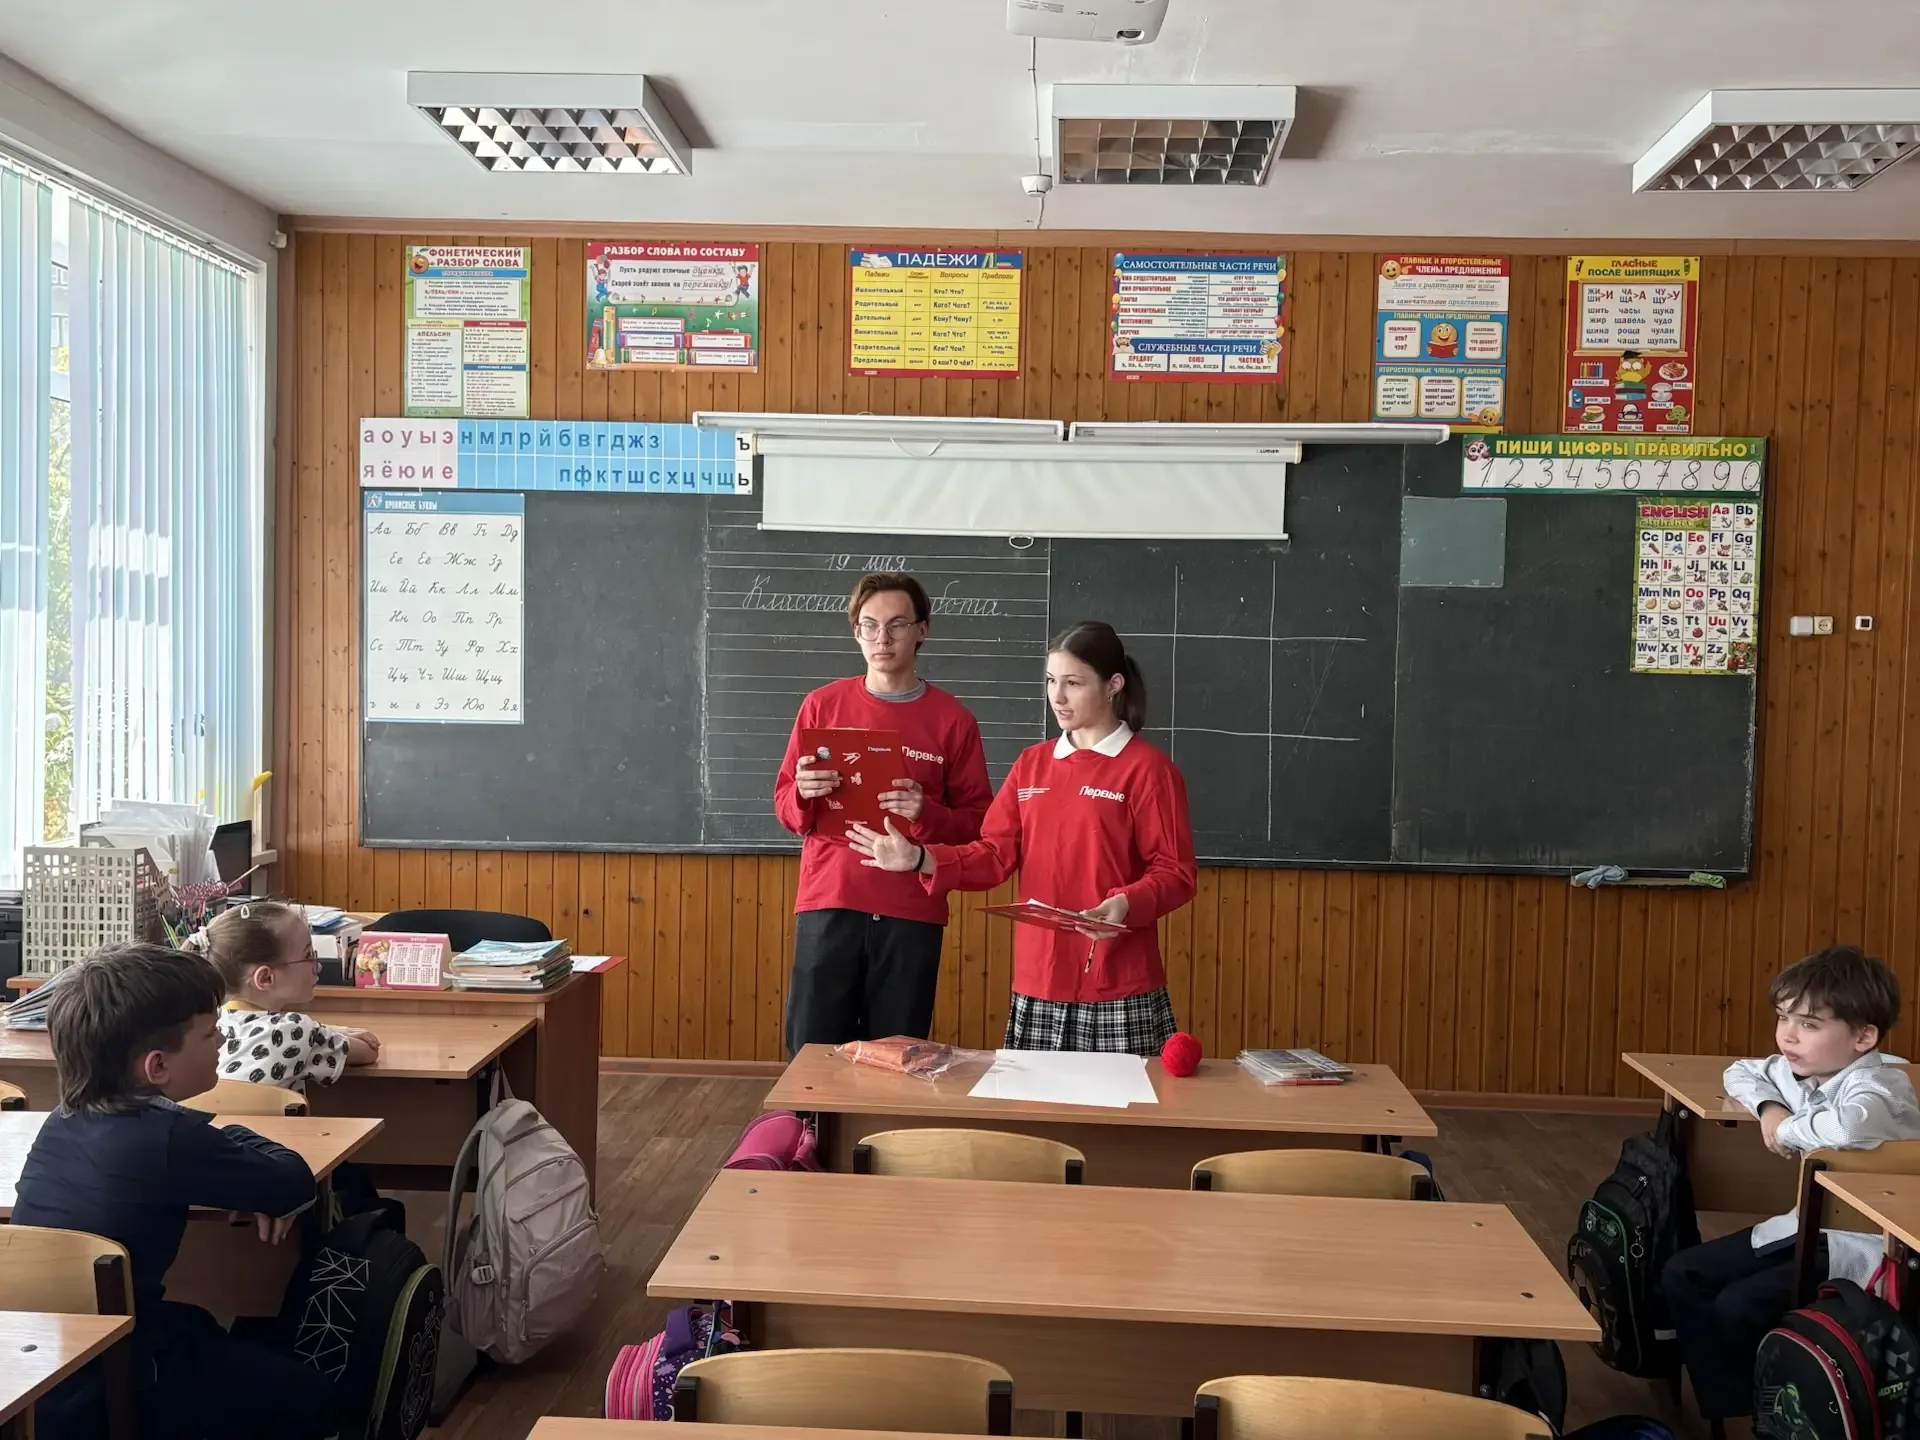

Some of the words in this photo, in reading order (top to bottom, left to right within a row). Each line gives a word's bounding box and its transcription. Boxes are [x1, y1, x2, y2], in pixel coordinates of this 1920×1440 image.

[429, 248, 521, 257] ФОНЕТИЧЕСКИЙ
[604, 247, 644, 255] РАЗБОР
[647, 247, 681, 256] СЛОВА
[684, 247, 697, 256] ПО
[700, 248, 745, 256] СОСТАВУ
[483, 259, 519, 267] СЛОВА
[897, 253, 977, 266] ПАДЕЖИ
[1441, 258, 1501, 266] ВТОРОСТЕПЕННЫЕ
[1611, 260, 1658, 268] ГЛАСНЫЕ
[619, 266, 636, 274] Пусть
[1123, 261, 1218, 270] САМОСТОЯТЕЛЬНЫЕ
[1219, 261, 1251, 270] ЧАСТИ
[1253, 262, 1276, 271] РЕЧИ
[1445, 266, 1501, 275] ПРЕДЛОЖЕНИЯ
[1588, 268, 1621, 276] ПОСЛЕ
[1624, 268, 1680, 277] ШИПЯЩИХ
[611, 279, 631, 287] Скорей
[1654, 317, 1673, 325] чудо
[1138, 344, 1196, 352] СЛУЖЕБНЫЕ
[1199, 344, 1231, 353] ЧАСТИ
[1234, 344, 1256, 353] РЕЧИ
[1496, 440, 1552, 454] ПИШИ
[1559, 441, 1628, 456] ЦИФРЫ
[1634, 442, 1748, 457] ПРАВИЛЬНО
[1641, 505, 1709, 518] ENGLISH
[1712, 505, 1730, 515] Aa
[1736, 505, 1753, 515] Bb
[1642, 532, 1658, 542] Cc
[1664, 532, 1682, 542] Dd
[1688, 532, 1704, 542] Ee
[1711, 532, 1724, 542] Ff
[1735, 533, 1753, 545] Gg
[825, 553, 850, 571] 19
[1640, 559, 1658, 569] Hh
[1663, 559, 1672, 569] Ii
[1687, 560, 1699, 572] Jj
[1710, 560, 1727, 570] Kk
[1734, 561, 1745, 571] Ll
[742, 575, 849, 612] Классна
[1639, 587, 1660, 597] Mm
[1662, 587, 1680, 597] Nn
[1686, 588, 1704, 598] Oo
[1709, 588, 1726, 601] Pp
[1732, 589, 1750, 601] Qq
[1639, 615, 1653, 625] Rr
[1662, 615, 1677, 625] Ss
[1685, 616, 1699, 625] Tt
[1708, 616, 1726, 626] Uu
[1732, 617, 1748, 626] Vv
[1637, 642, 1657, 652] Ww
[1660, 643, 1677, 652] Xx
[1684, 644, 1700, 655] Yy
[1707, 644, 1723, 654] Zz
[902, 745, 944, 764] Первые
[1079, 785, 1125, 802] Первые
